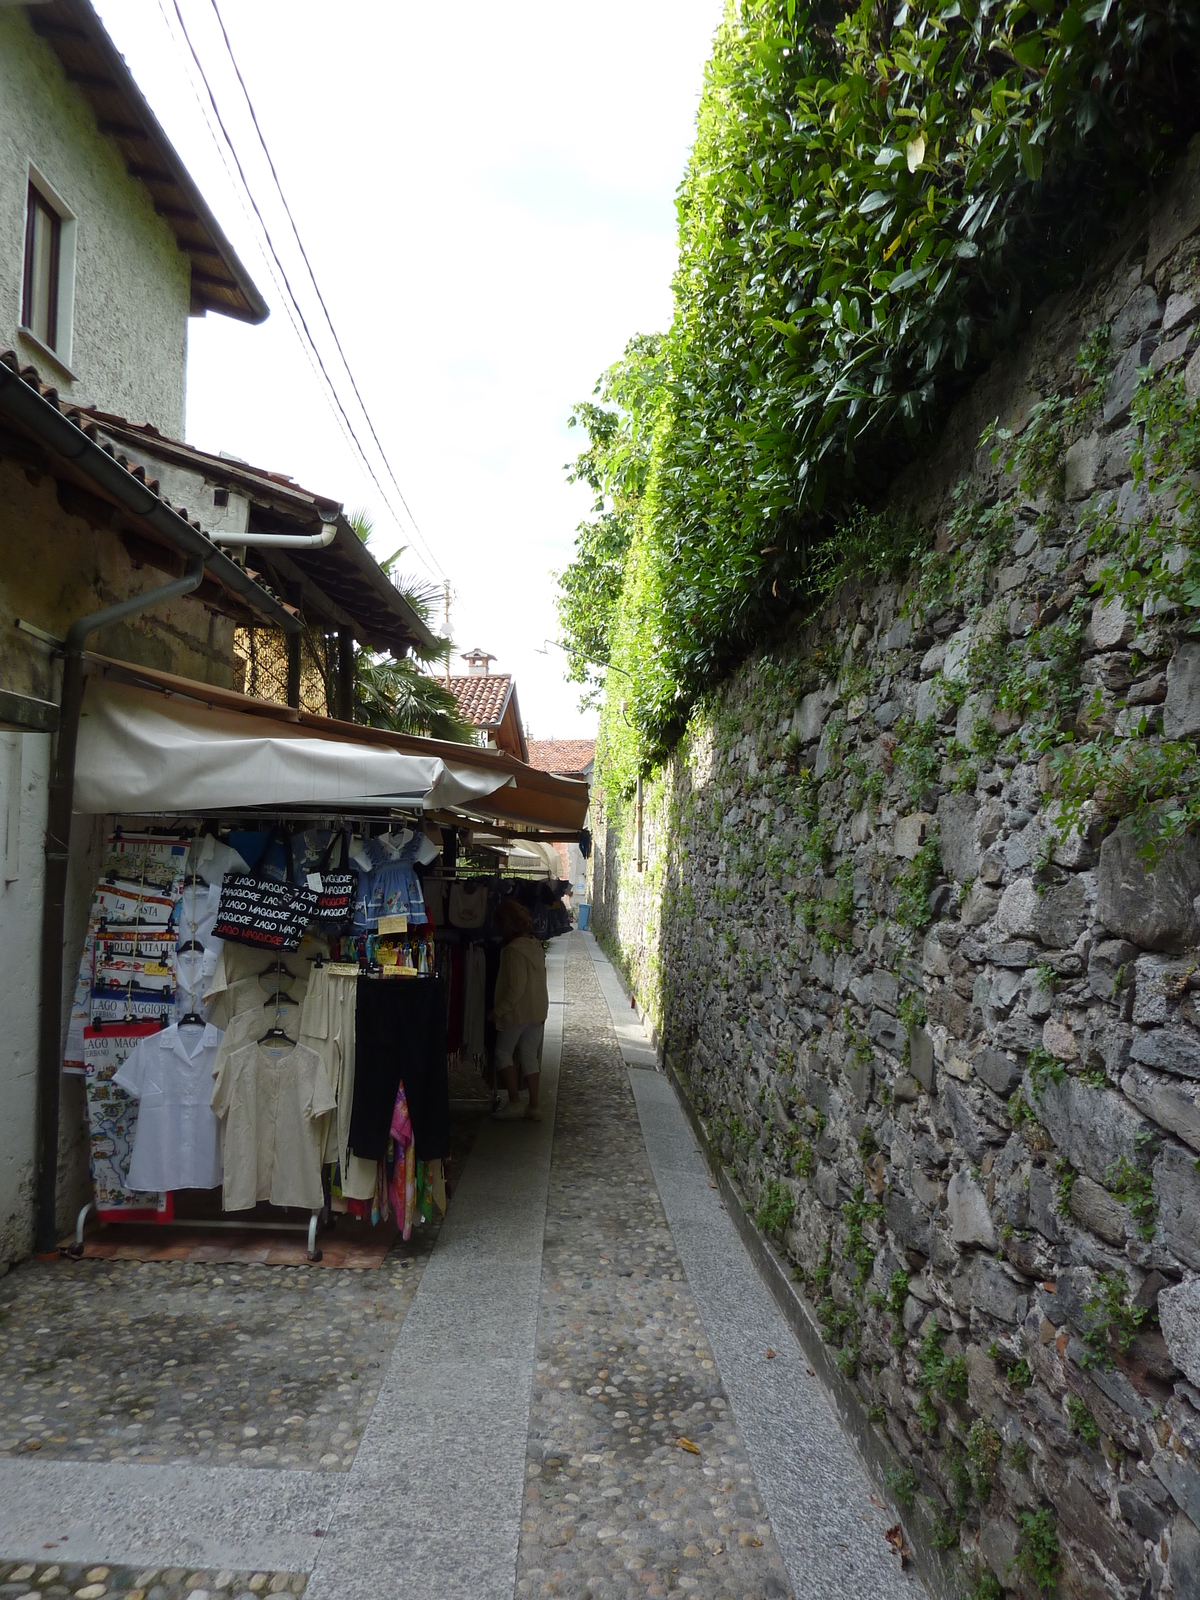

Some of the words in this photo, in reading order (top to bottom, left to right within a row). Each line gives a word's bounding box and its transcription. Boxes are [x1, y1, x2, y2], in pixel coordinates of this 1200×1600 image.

[133, 843, 164, 853] ITALIA
[234, 877, 256, 887] LAGO
[115, 899, 126, 911] La
[225, 899, 247, 911] LAGO
[248, 904, 291, 921] MAGGIORE
[253, 919, 277, 931] LAGO
[217, 924, 240, 936] LAGO
[241, 928, 284, 946] MAGGIORE
[92, 1000, 118, 1012] LAGO
[123, 1002, 173, 1015] MAGGIORE
[85, 1049, 109, 1058] ERBANO
